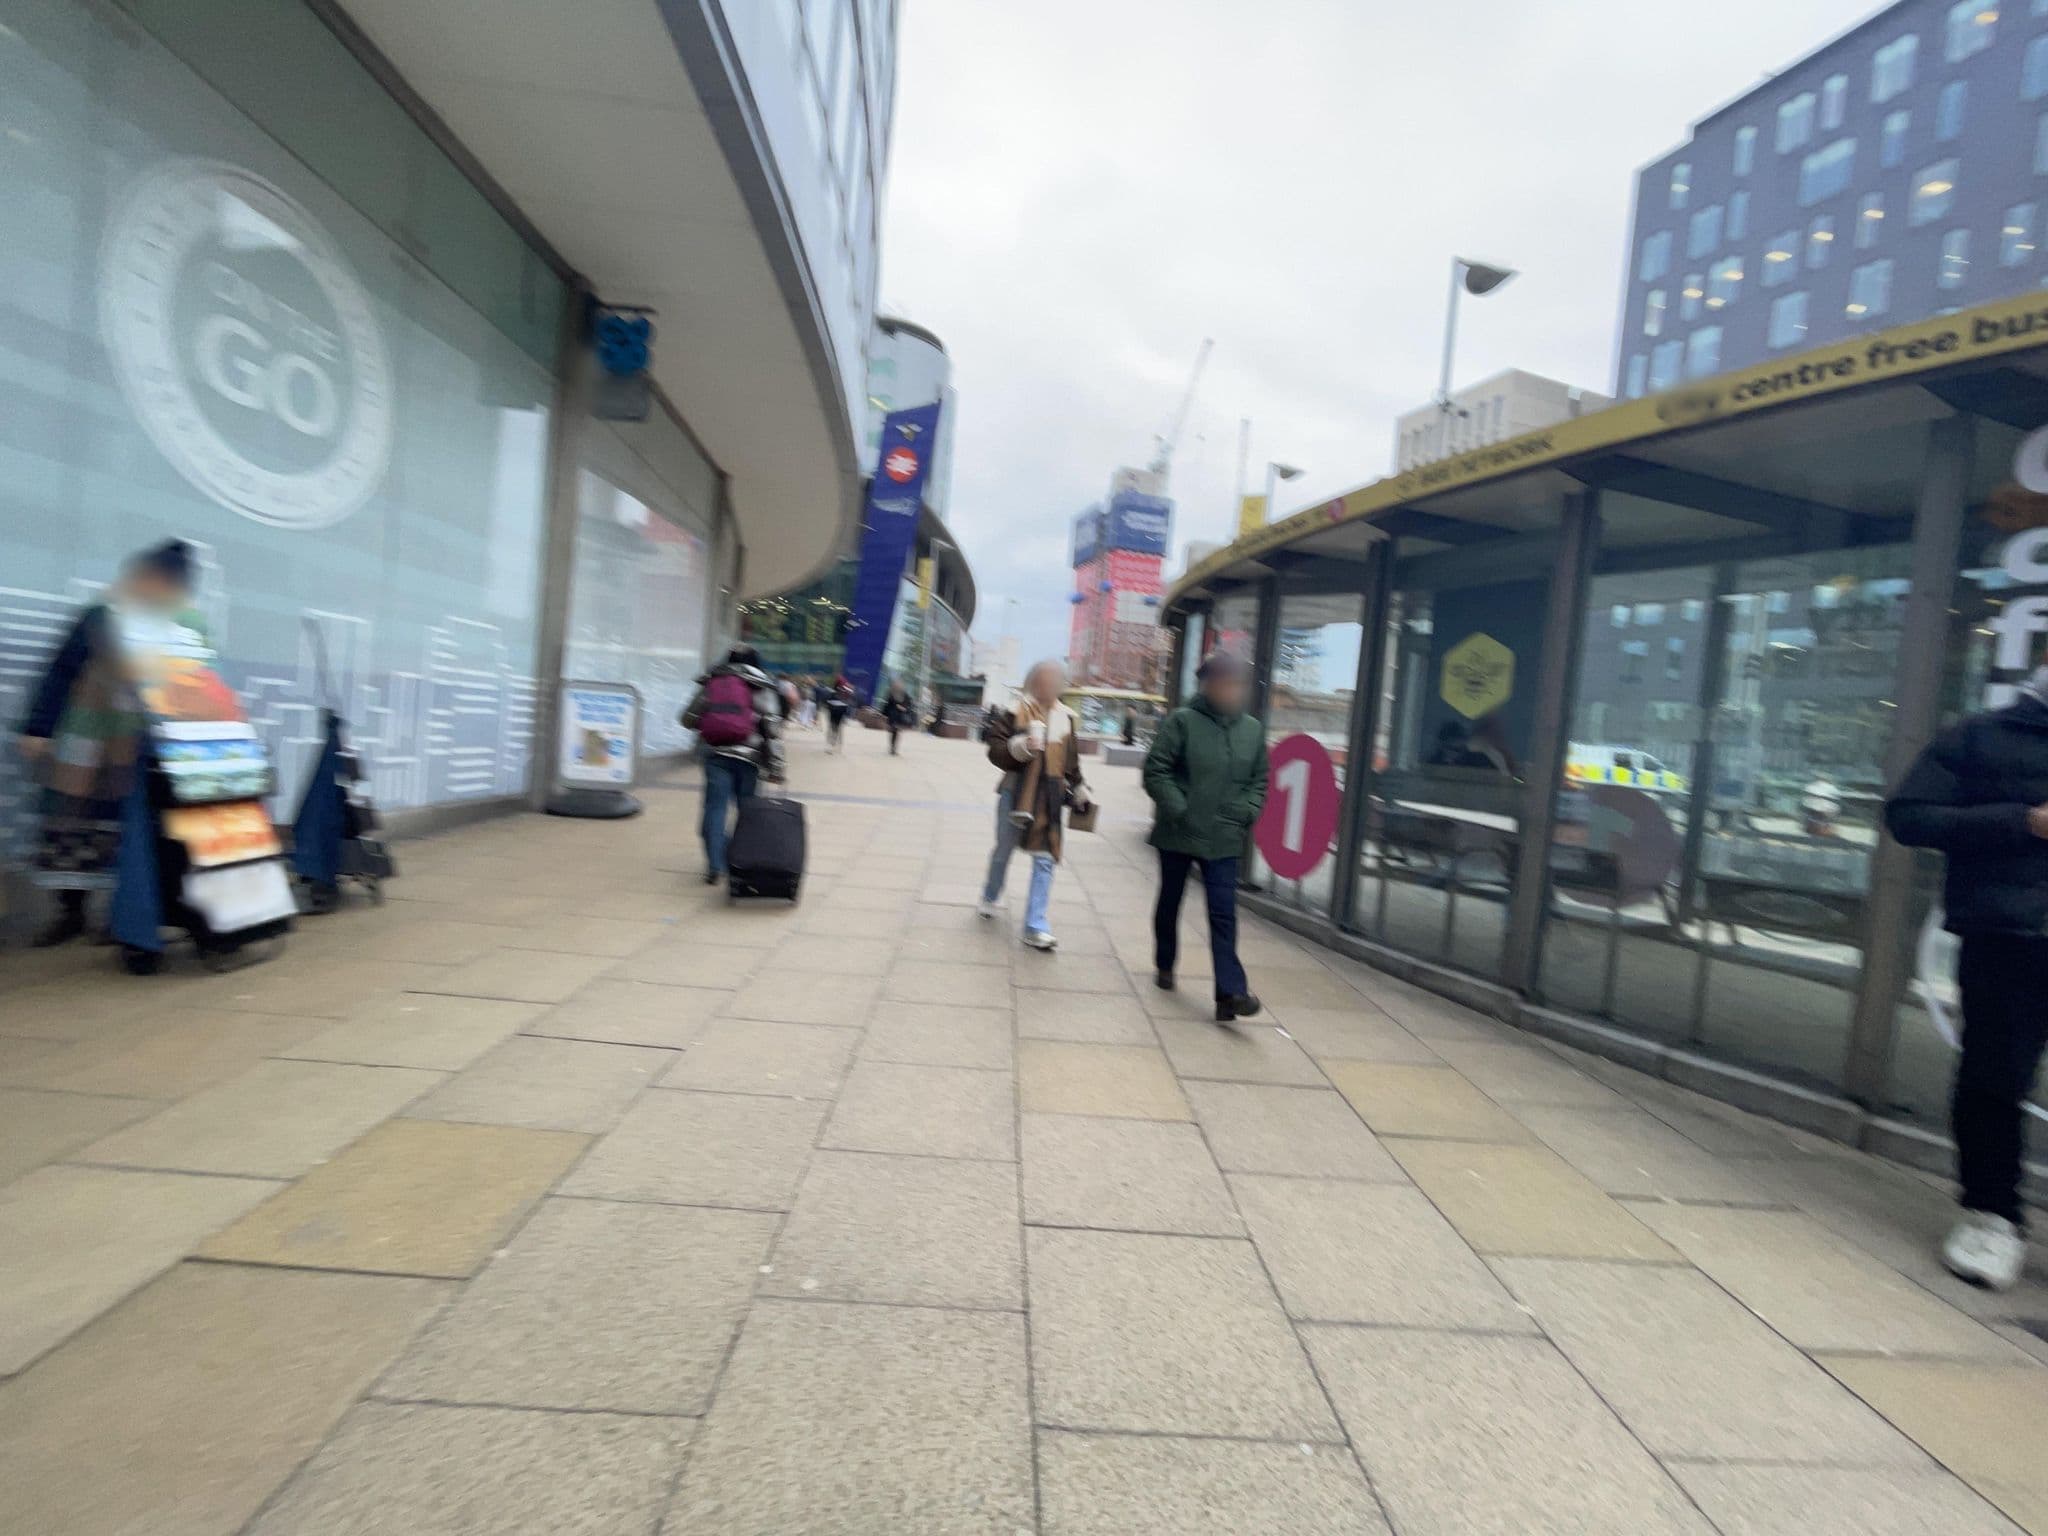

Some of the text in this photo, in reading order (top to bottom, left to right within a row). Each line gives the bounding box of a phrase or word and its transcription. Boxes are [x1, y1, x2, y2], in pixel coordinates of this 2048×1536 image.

[194, 312, 338, 437] GO
[1731, 354, 1856, 402] centre
[1866, 330, 1960, 368] free
[1275, 757, 1312, 855] 1
